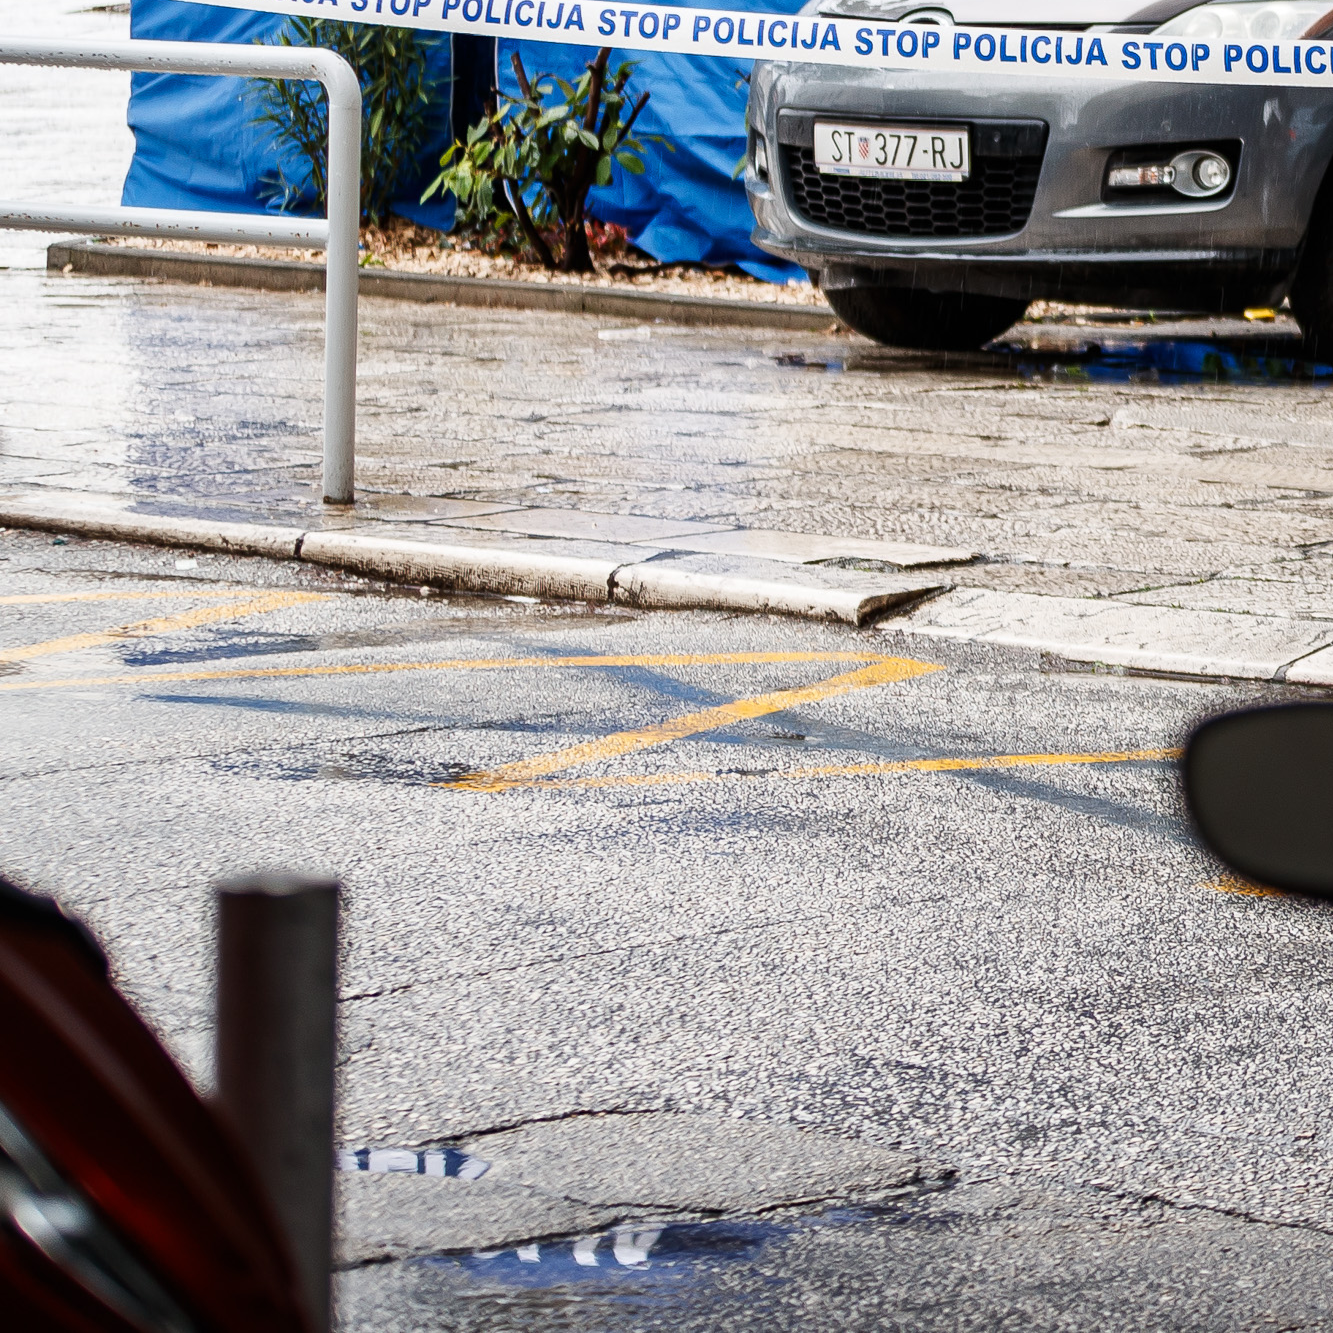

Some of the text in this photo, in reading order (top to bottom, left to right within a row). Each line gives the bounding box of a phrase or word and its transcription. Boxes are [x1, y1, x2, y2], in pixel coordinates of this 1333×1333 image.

[598, 9, 681, 40] STOP
[692, 15, 841, 51] POLICIJA
[854, 27, 940, 59] STOP
[953, 32, 1108, 66] POLICIJA
[1121, 41, 1210, 72] STOP
[831, 130, 964, 169] ST 377-RJ
